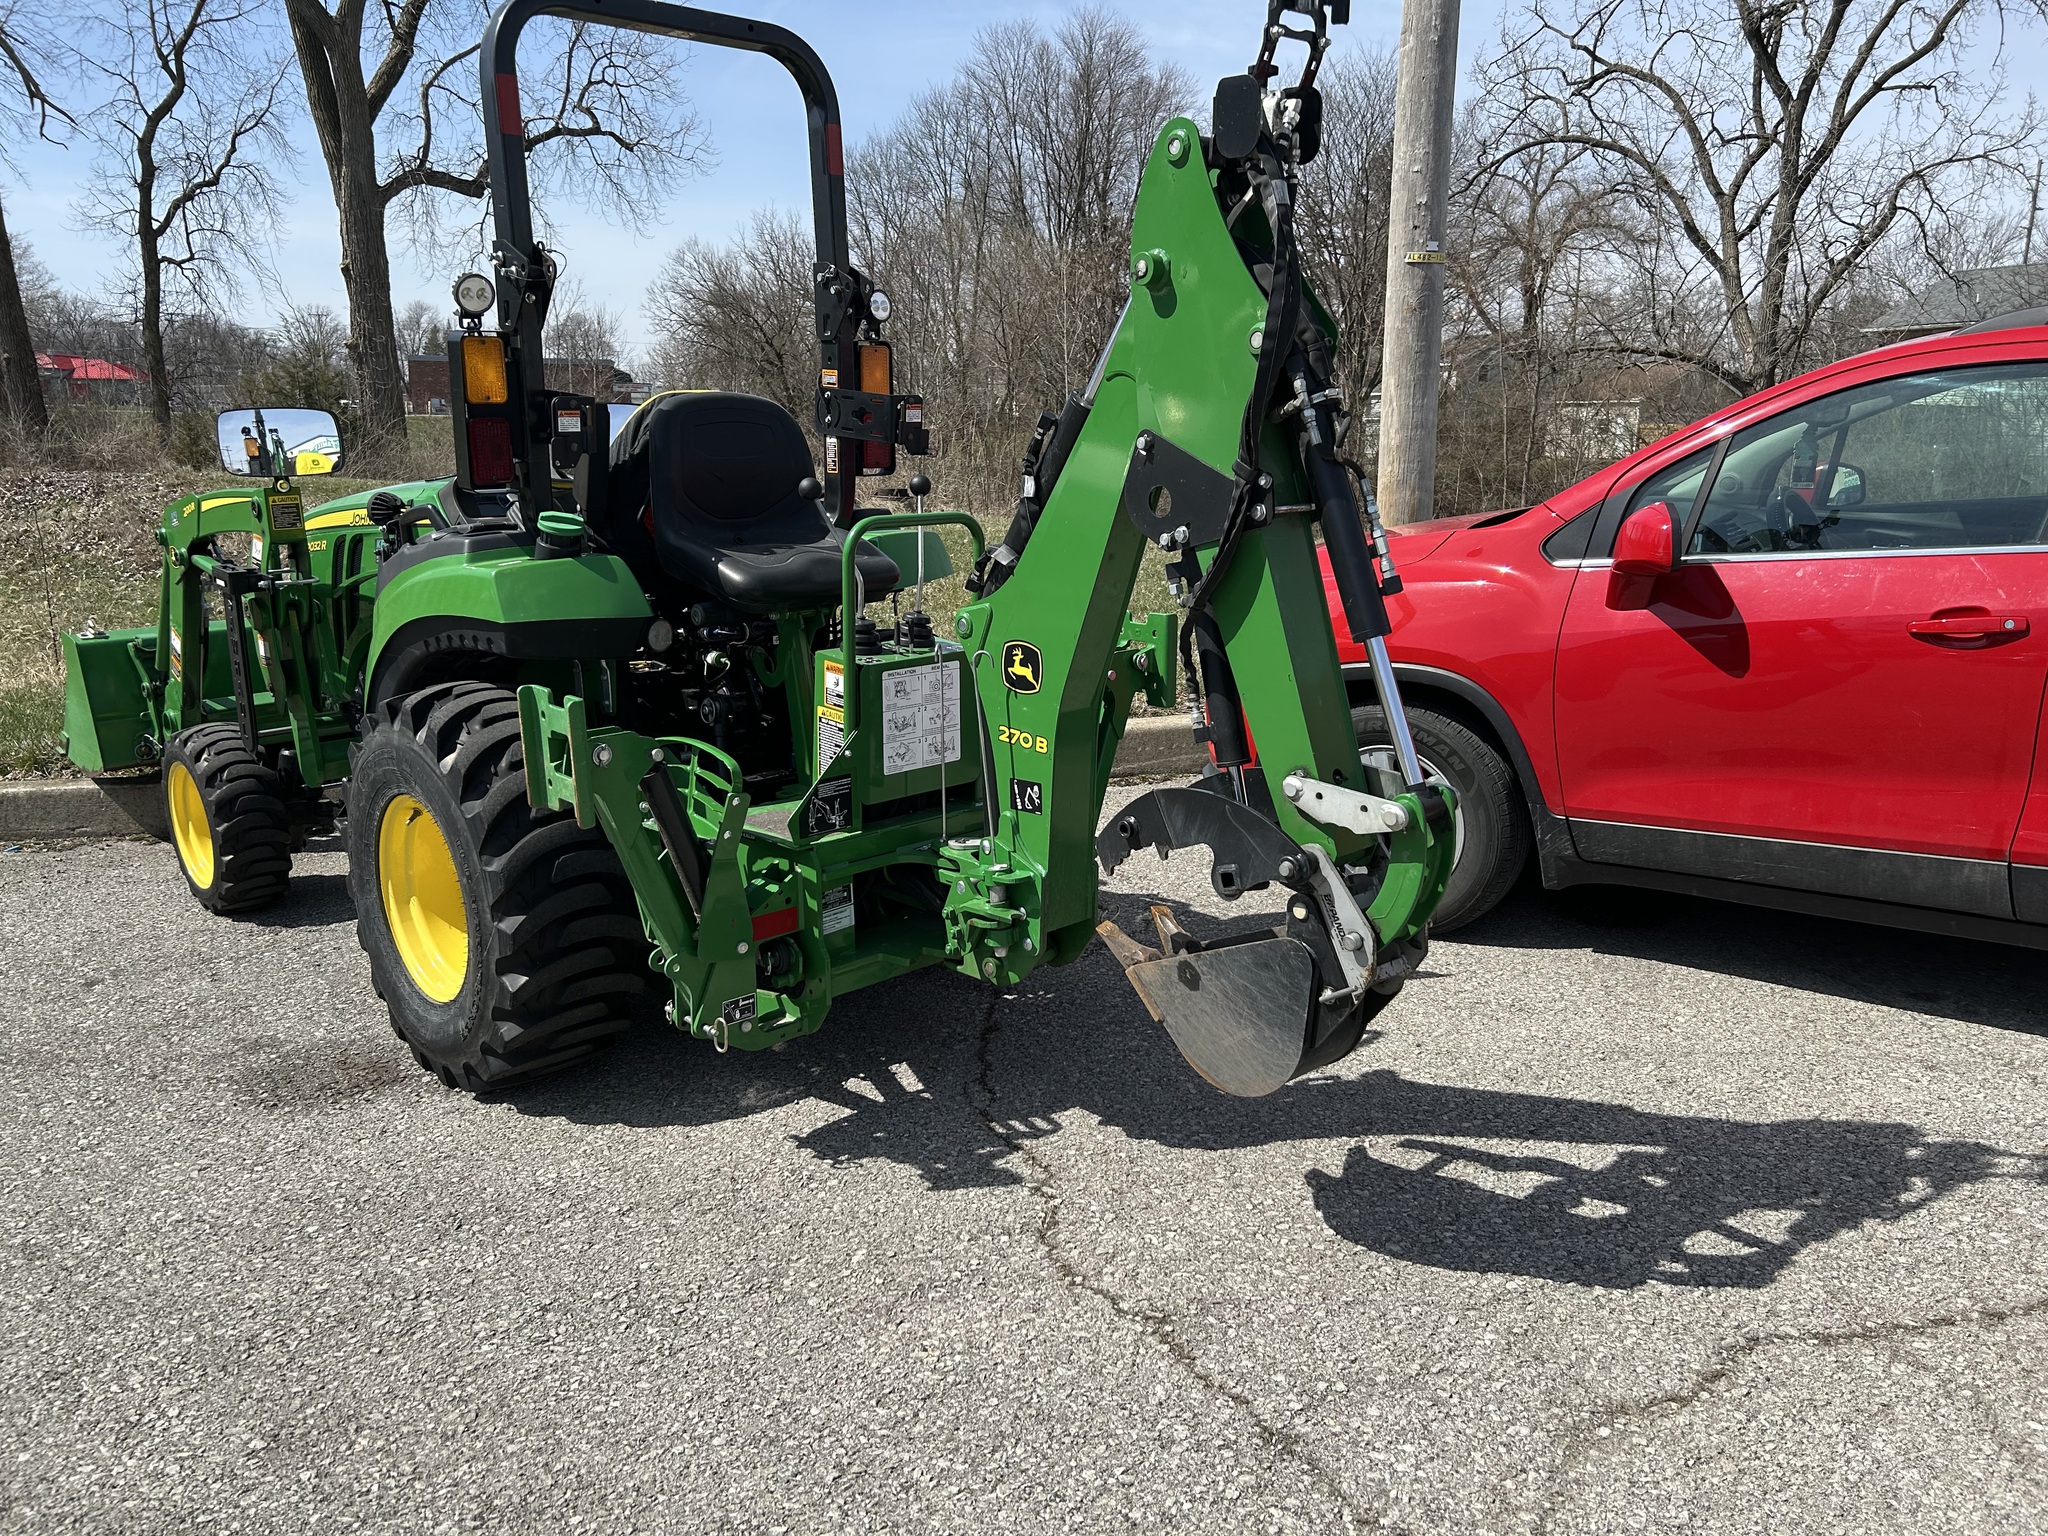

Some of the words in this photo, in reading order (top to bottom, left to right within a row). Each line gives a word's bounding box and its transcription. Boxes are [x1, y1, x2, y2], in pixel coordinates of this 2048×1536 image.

[887, 668, 917, 678] INSTALLATION
[826, 710, 844, 722] CAUTIO
[998, 724, 1034, 749] 270
[1035, 734, 1048, 754] B
[1357, 719, 1466, 771] IRMAN
